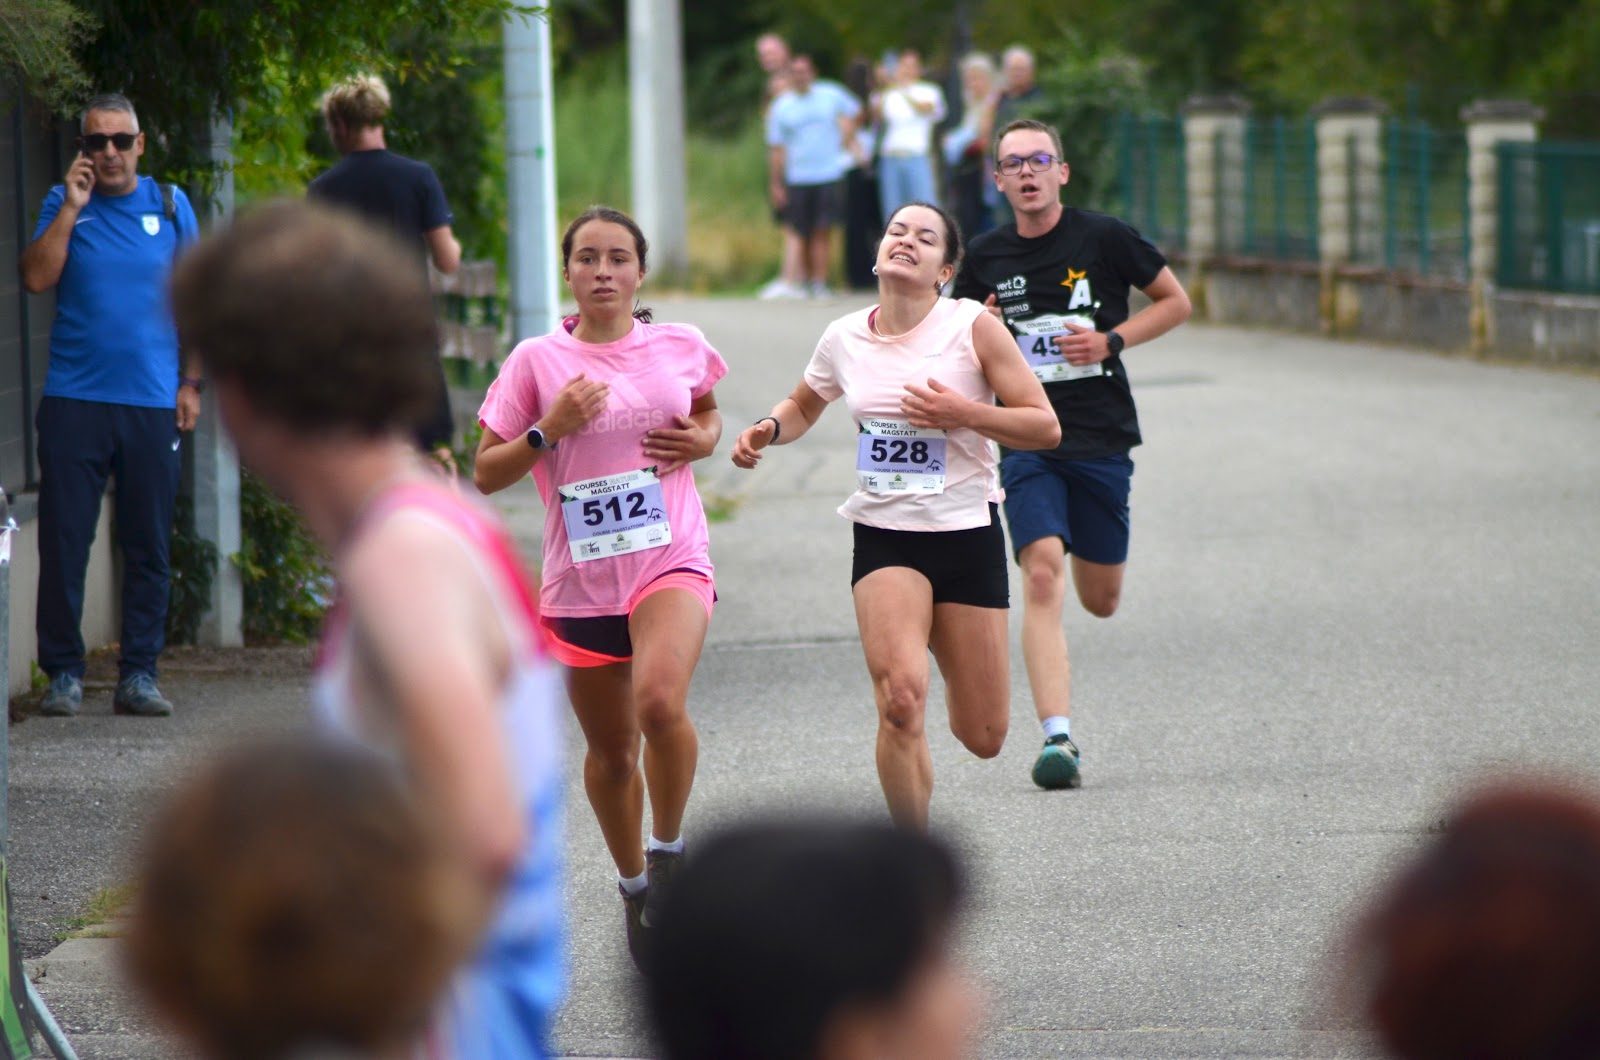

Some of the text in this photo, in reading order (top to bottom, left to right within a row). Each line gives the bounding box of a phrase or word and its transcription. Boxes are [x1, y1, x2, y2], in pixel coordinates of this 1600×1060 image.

[1068, 278, 1092, 310] A
[1038, 325, 1067, 333] MAGSTAT
[1031, 335, 1062, 357] 45
[870, 421, 898, 429] COURSES
[881, 429, 918, 437] MAGSTATT
[870, 438, 929, 465] 528
[574, 479, 608, 492] COURSES
[590, 482, 630, 496] MAGSTATT
[583, 491, 648, 527] 512
